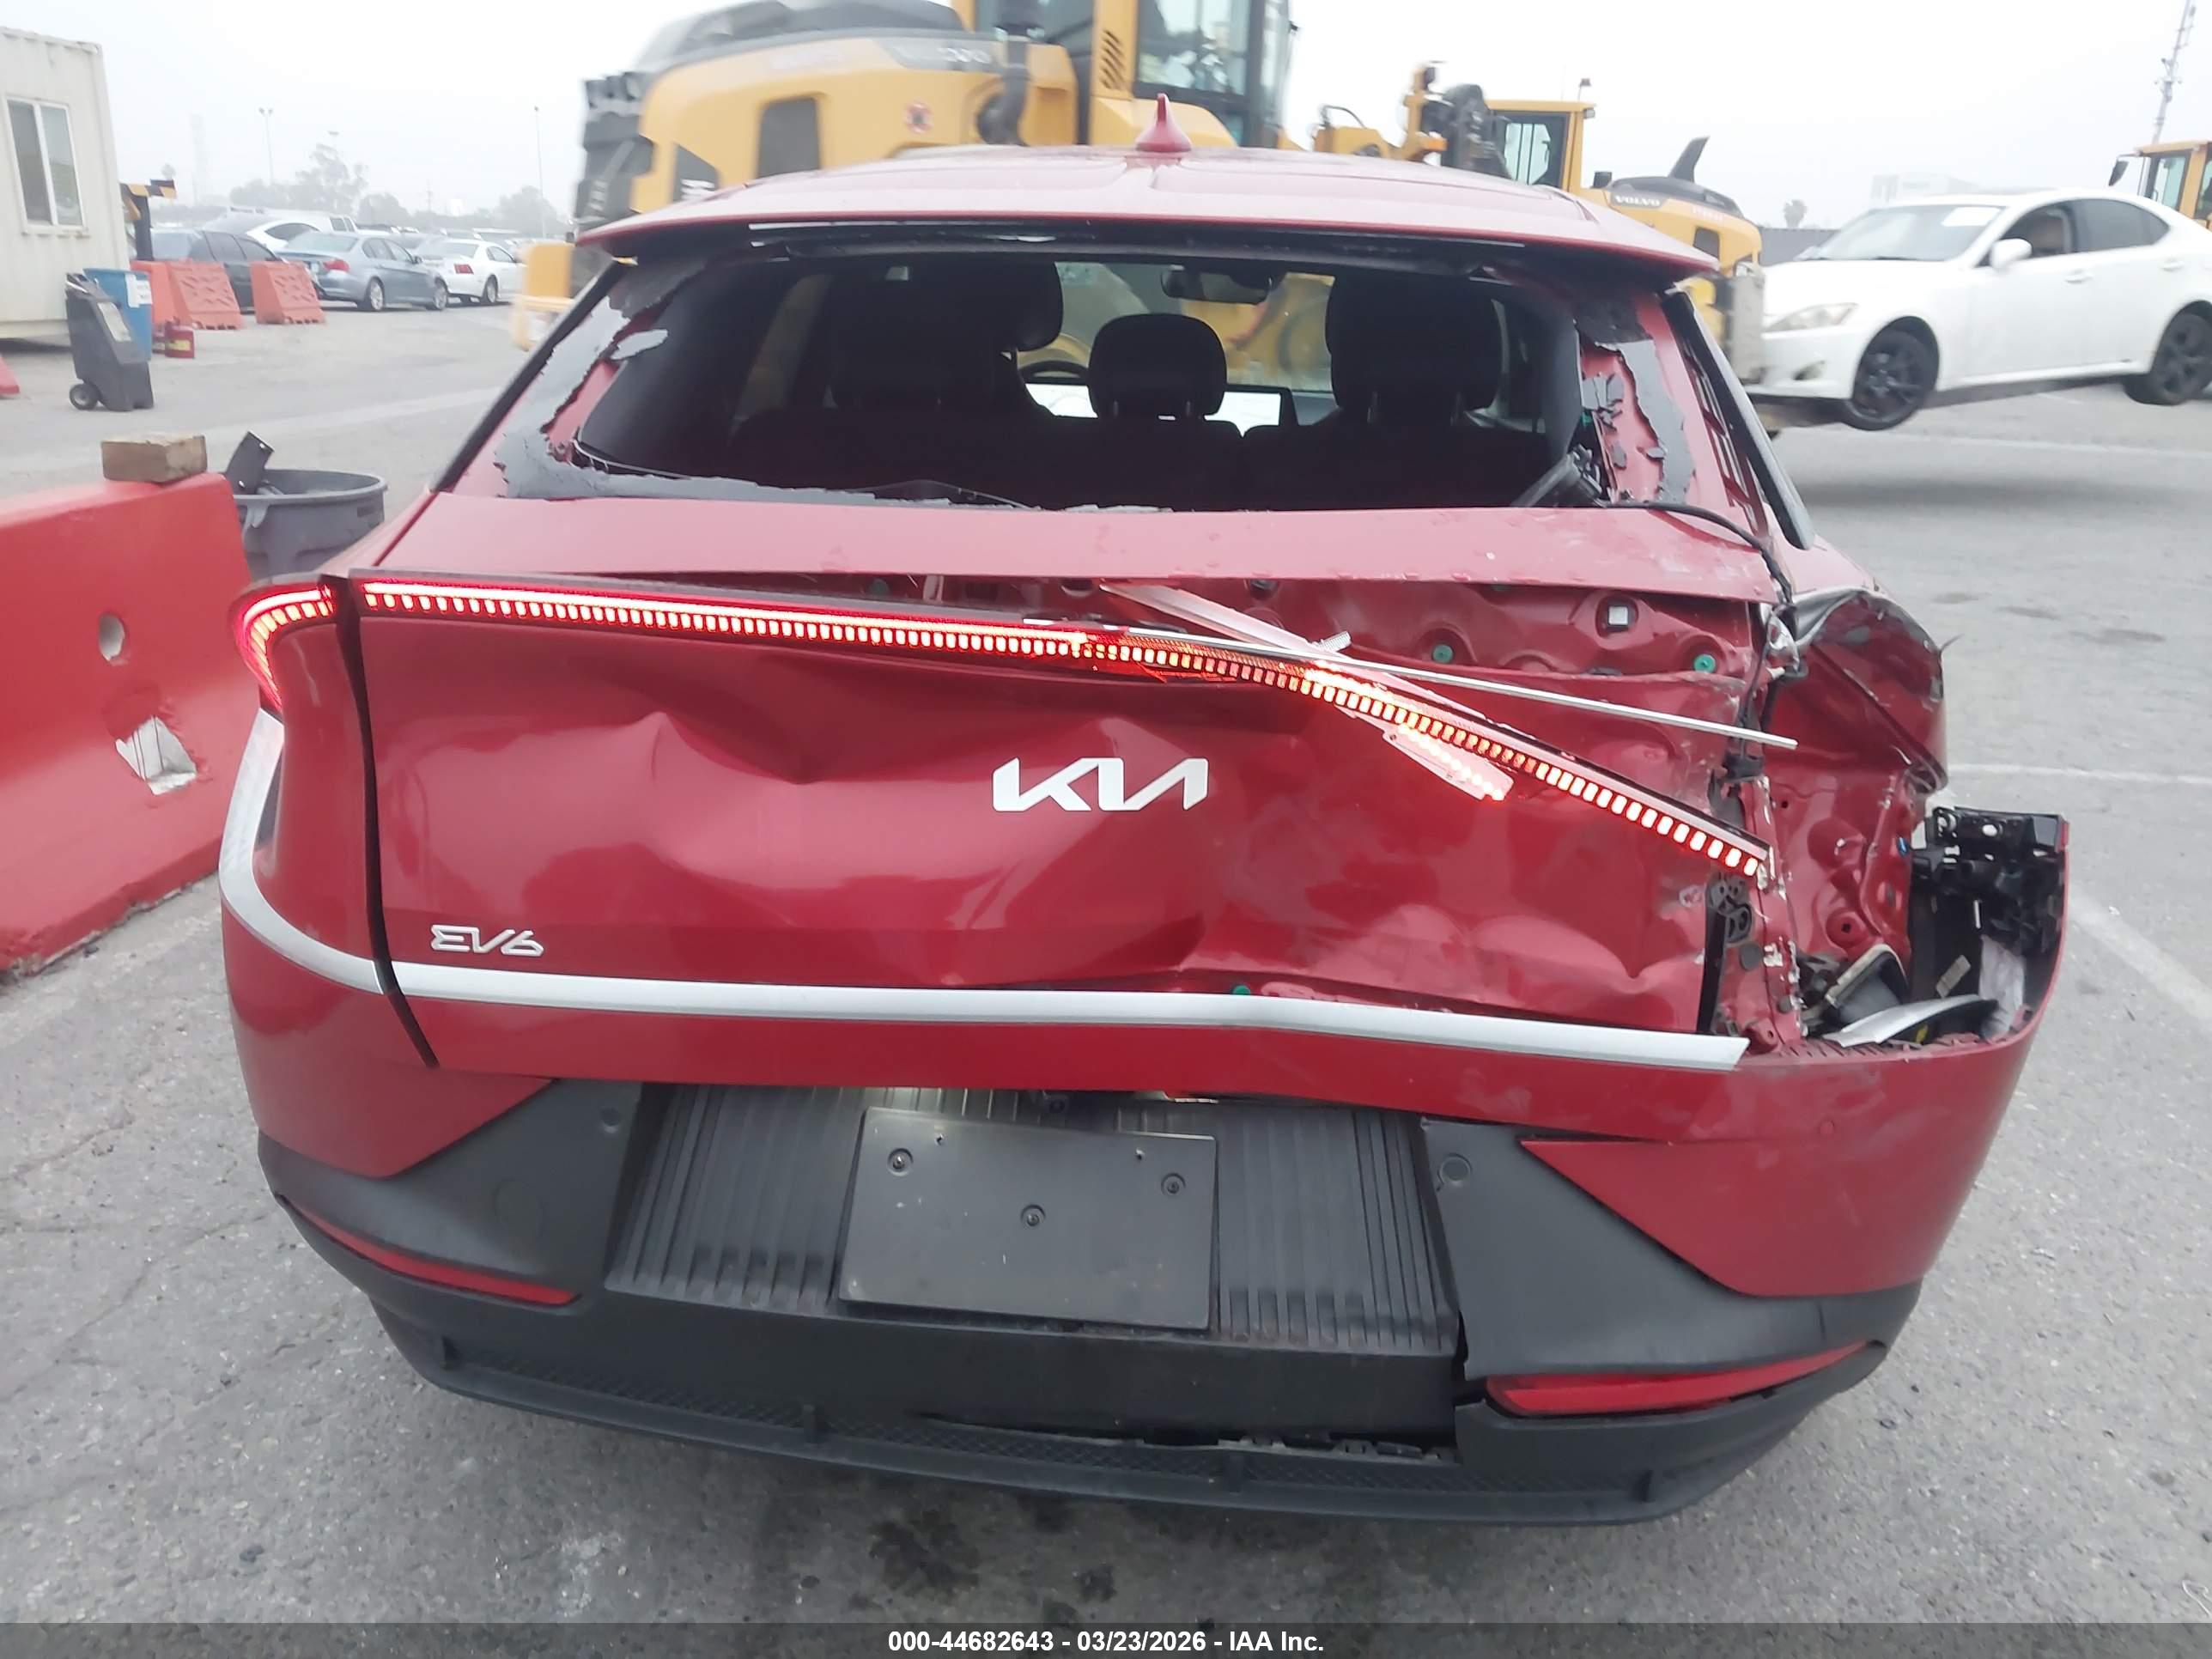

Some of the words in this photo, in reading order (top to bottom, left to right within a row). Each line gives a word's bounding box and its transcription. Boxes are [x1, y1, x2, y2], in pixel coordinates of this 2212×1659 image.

[1614, 195, 1661, 207] VOLVO
[993, 757, 1209, 811] KIA
[431, 924, 544, 957] EV6
